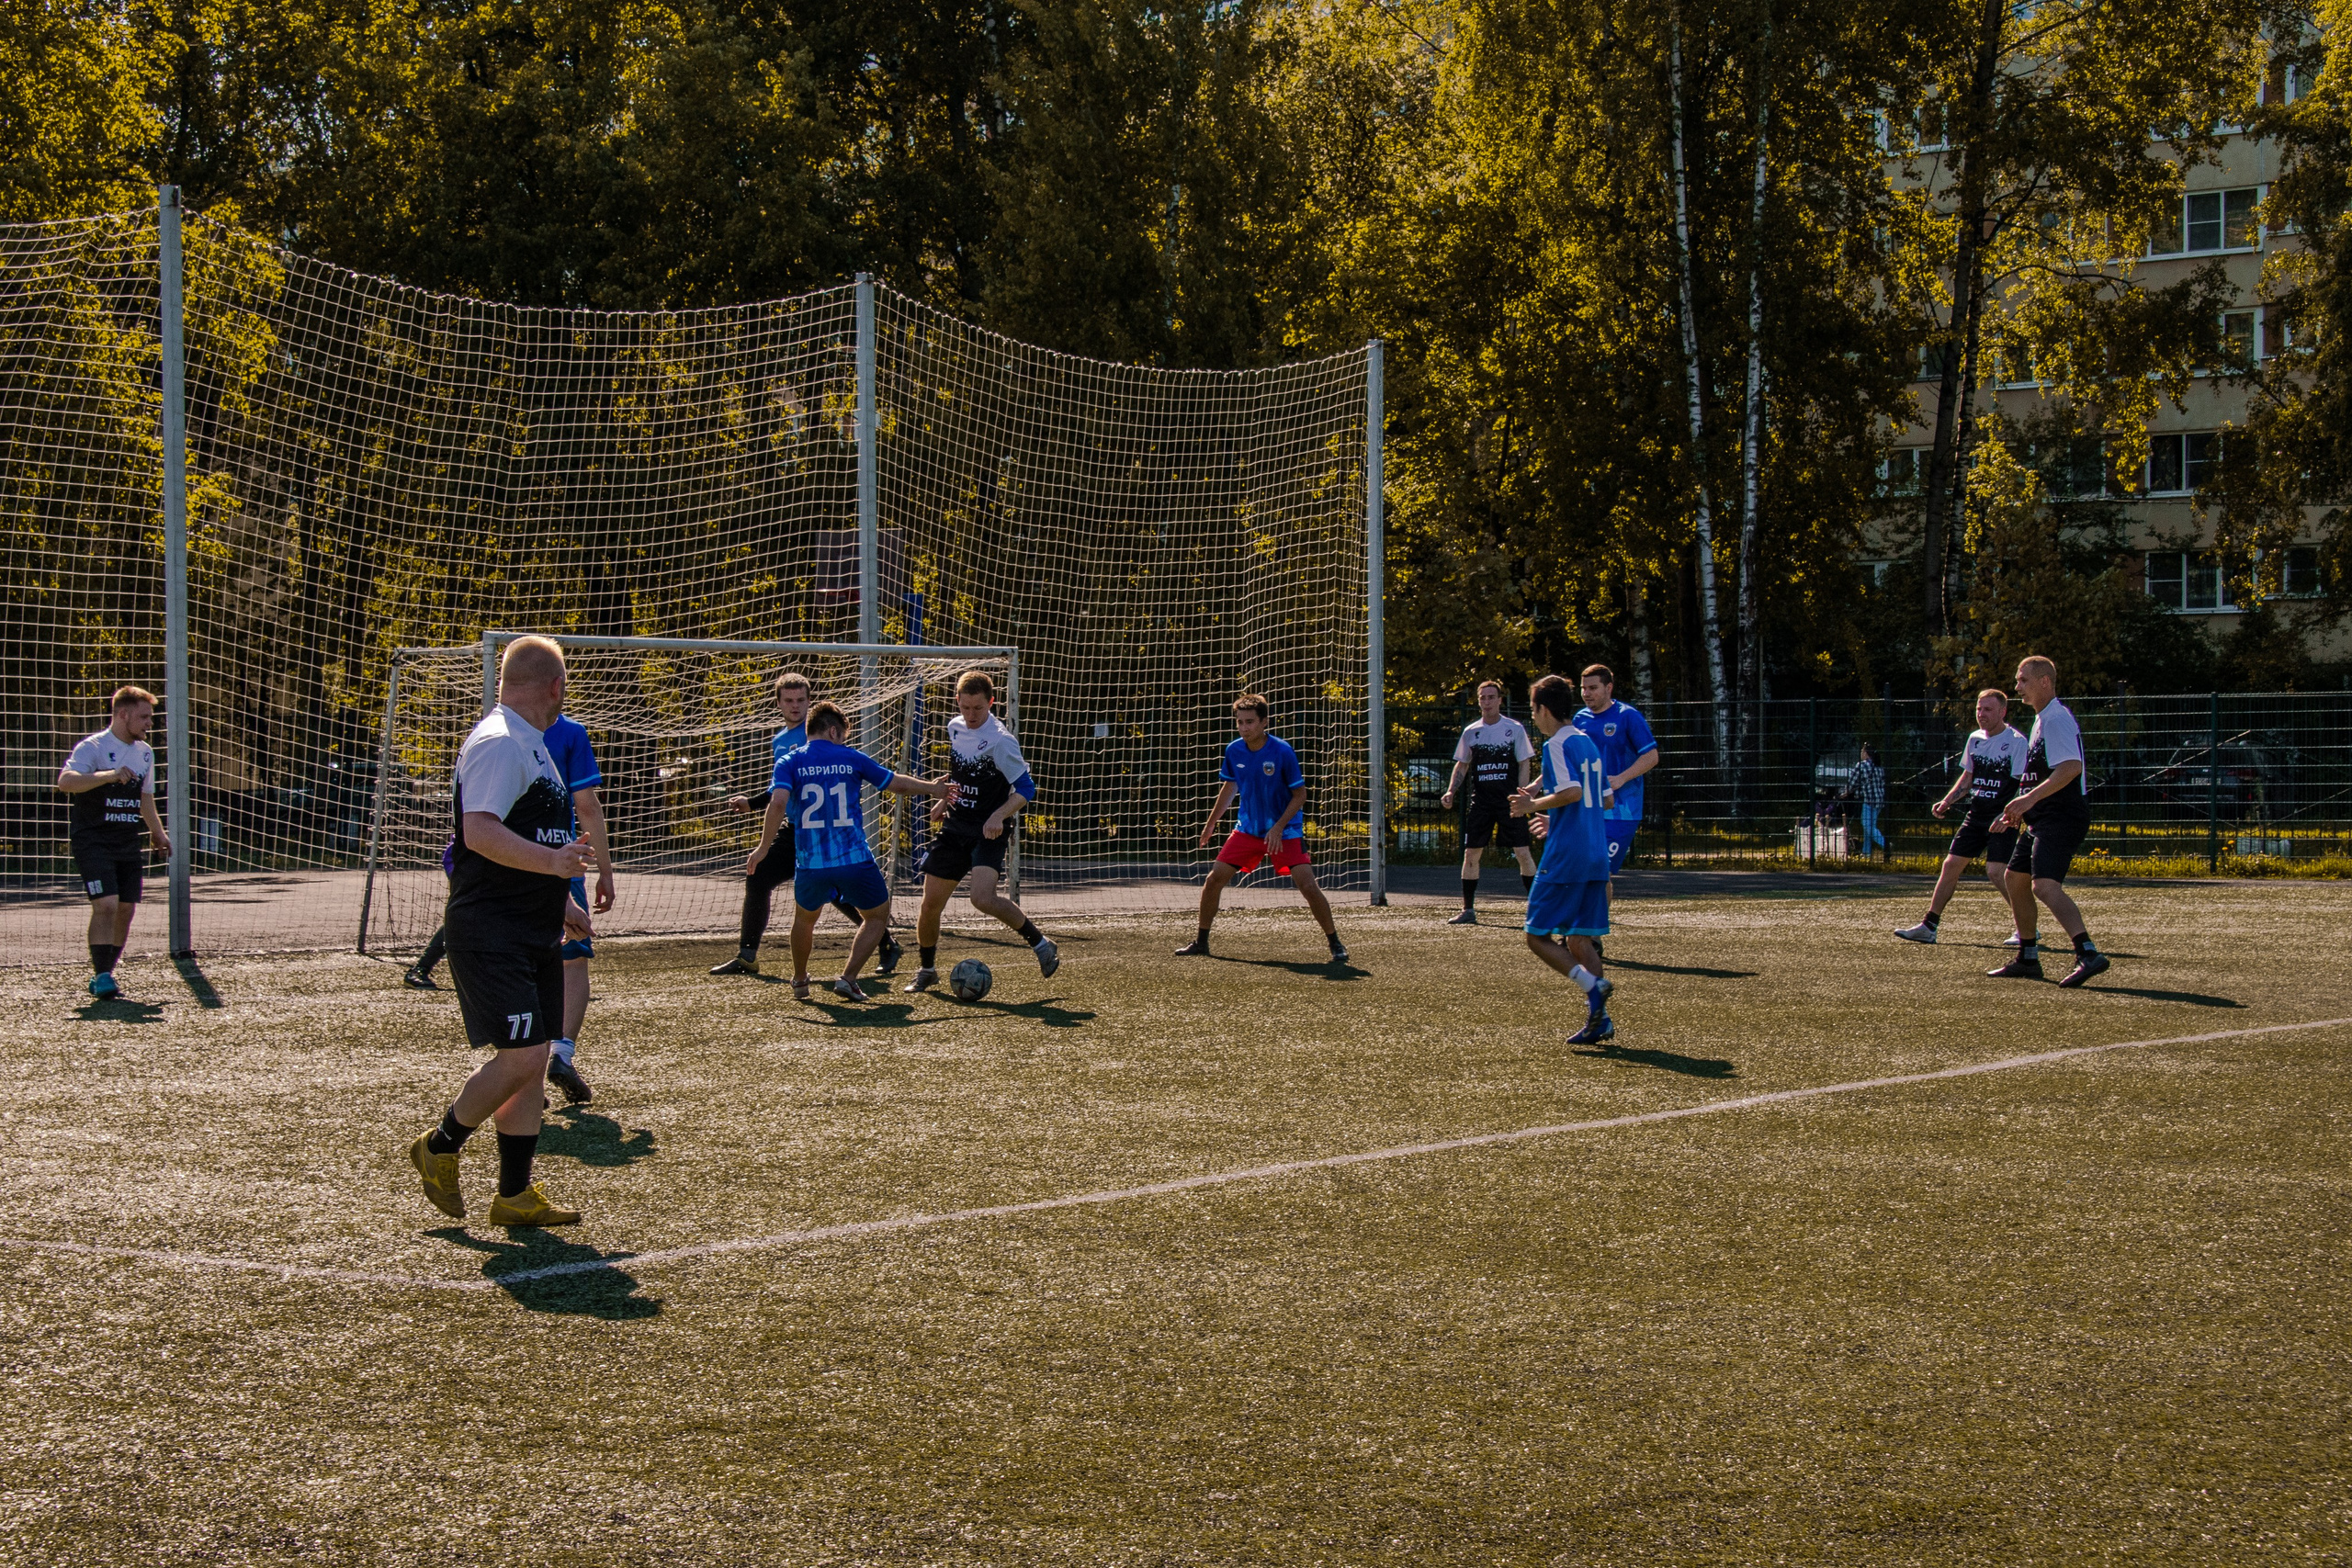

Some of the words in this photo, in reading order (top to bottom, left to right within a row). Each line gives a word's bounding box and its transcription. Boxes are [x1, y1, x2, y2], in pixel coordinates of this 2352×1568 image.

[797, 764, 853, 777] ГАВРИЛОВ
[1478, 773, 1508, 782] ИНВЕСТ
[1580, 758, 1602, 808] 11
[801, 782, 854, 829] 21
[1608, 841, 1620, 858] 9
[507, 1012, 533, 1040] 77
